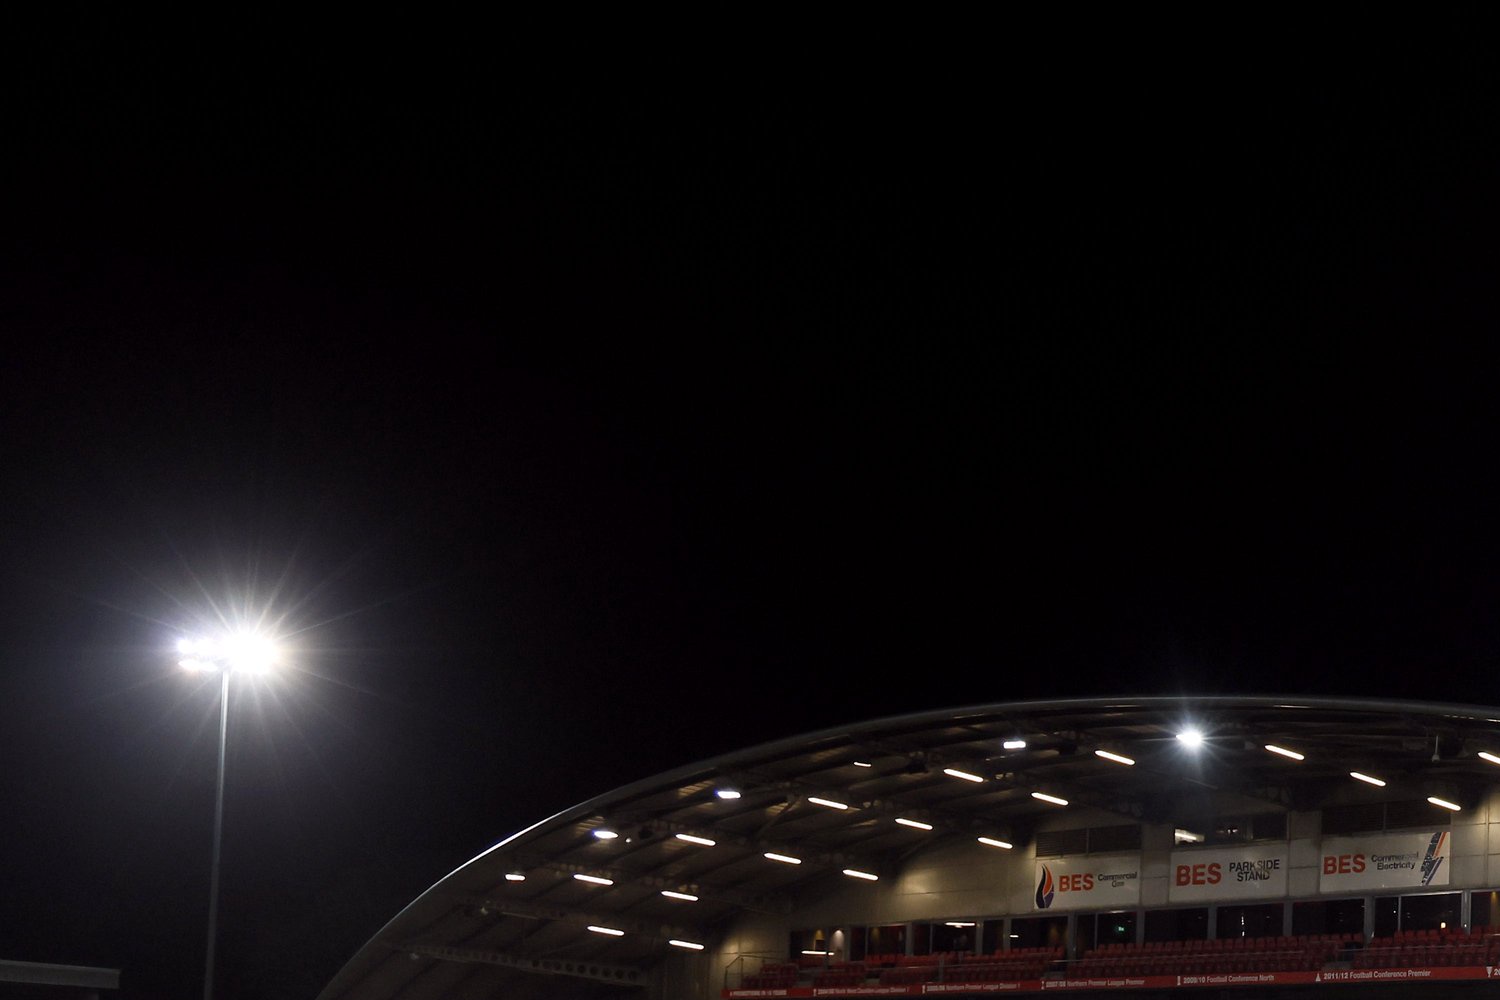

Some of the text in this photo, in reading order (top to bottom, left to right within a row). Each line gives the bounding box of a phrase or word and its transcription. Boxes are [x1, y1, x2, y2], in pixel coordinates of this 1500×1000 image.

[1229, 859, 1280, 873] PARKSIDE
[1323, 854, 1366, 875] BES
[1377, 860, 1416, 871] Electricity
[1097, 871, 1138, 882] Commercial
[1176, 863, 1222, 886] BES
[1237, 871, 1271, 882] STAND
[1059, 874, 1094, 892] BES
[1206, 975, 1228, 983] Football
[1323, 969, 1431, 980] 2011/12 Football Conference Premier
